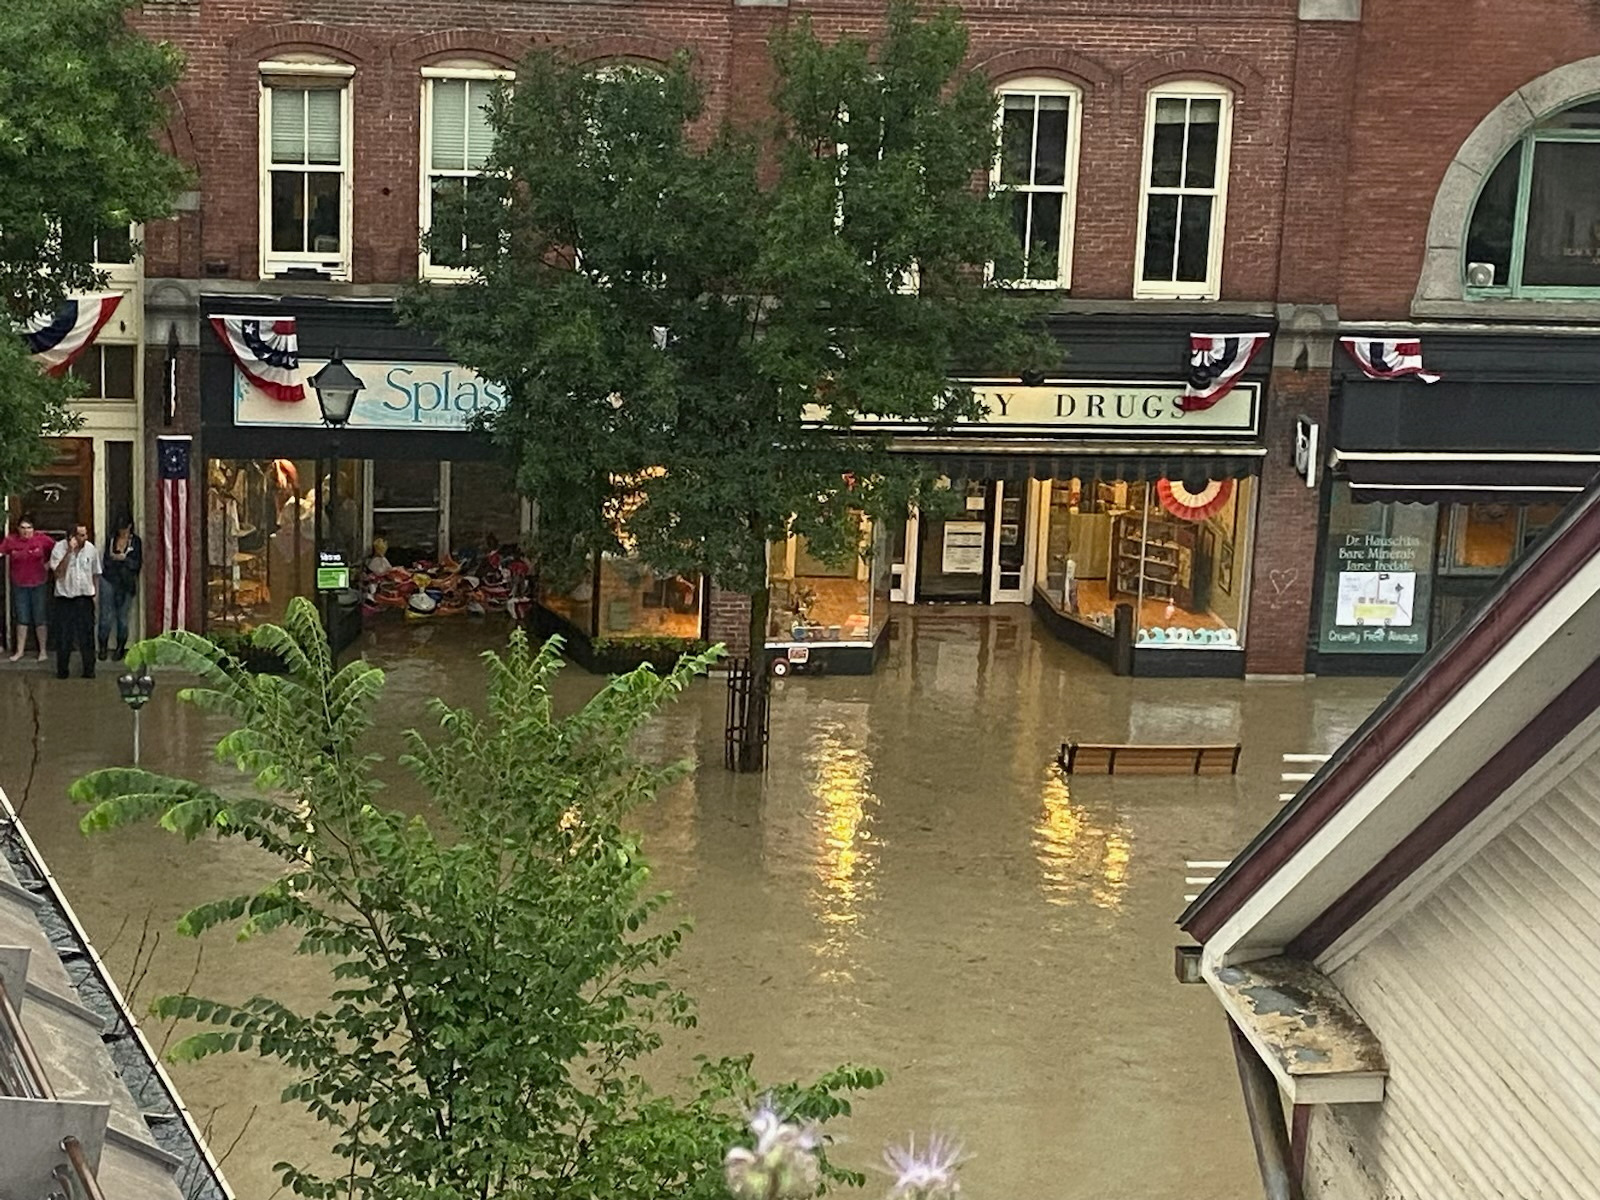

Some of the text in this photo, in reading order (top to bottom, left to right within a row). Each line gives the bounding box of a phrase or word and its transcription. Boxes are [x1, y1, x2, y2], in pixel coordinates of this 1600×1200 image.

[383, 368, 506, 422] Splas
[1055, 394, 1187, 419] DRUGS
[44, 490, 59, 503] 73
[1339, 547, 1415, 559] Bare Minerals
[1346, 560, 1372, 571] Jane
[1328, 630, 1360, 644] Cruelty
[1388, 630, 1418, 644] Always
